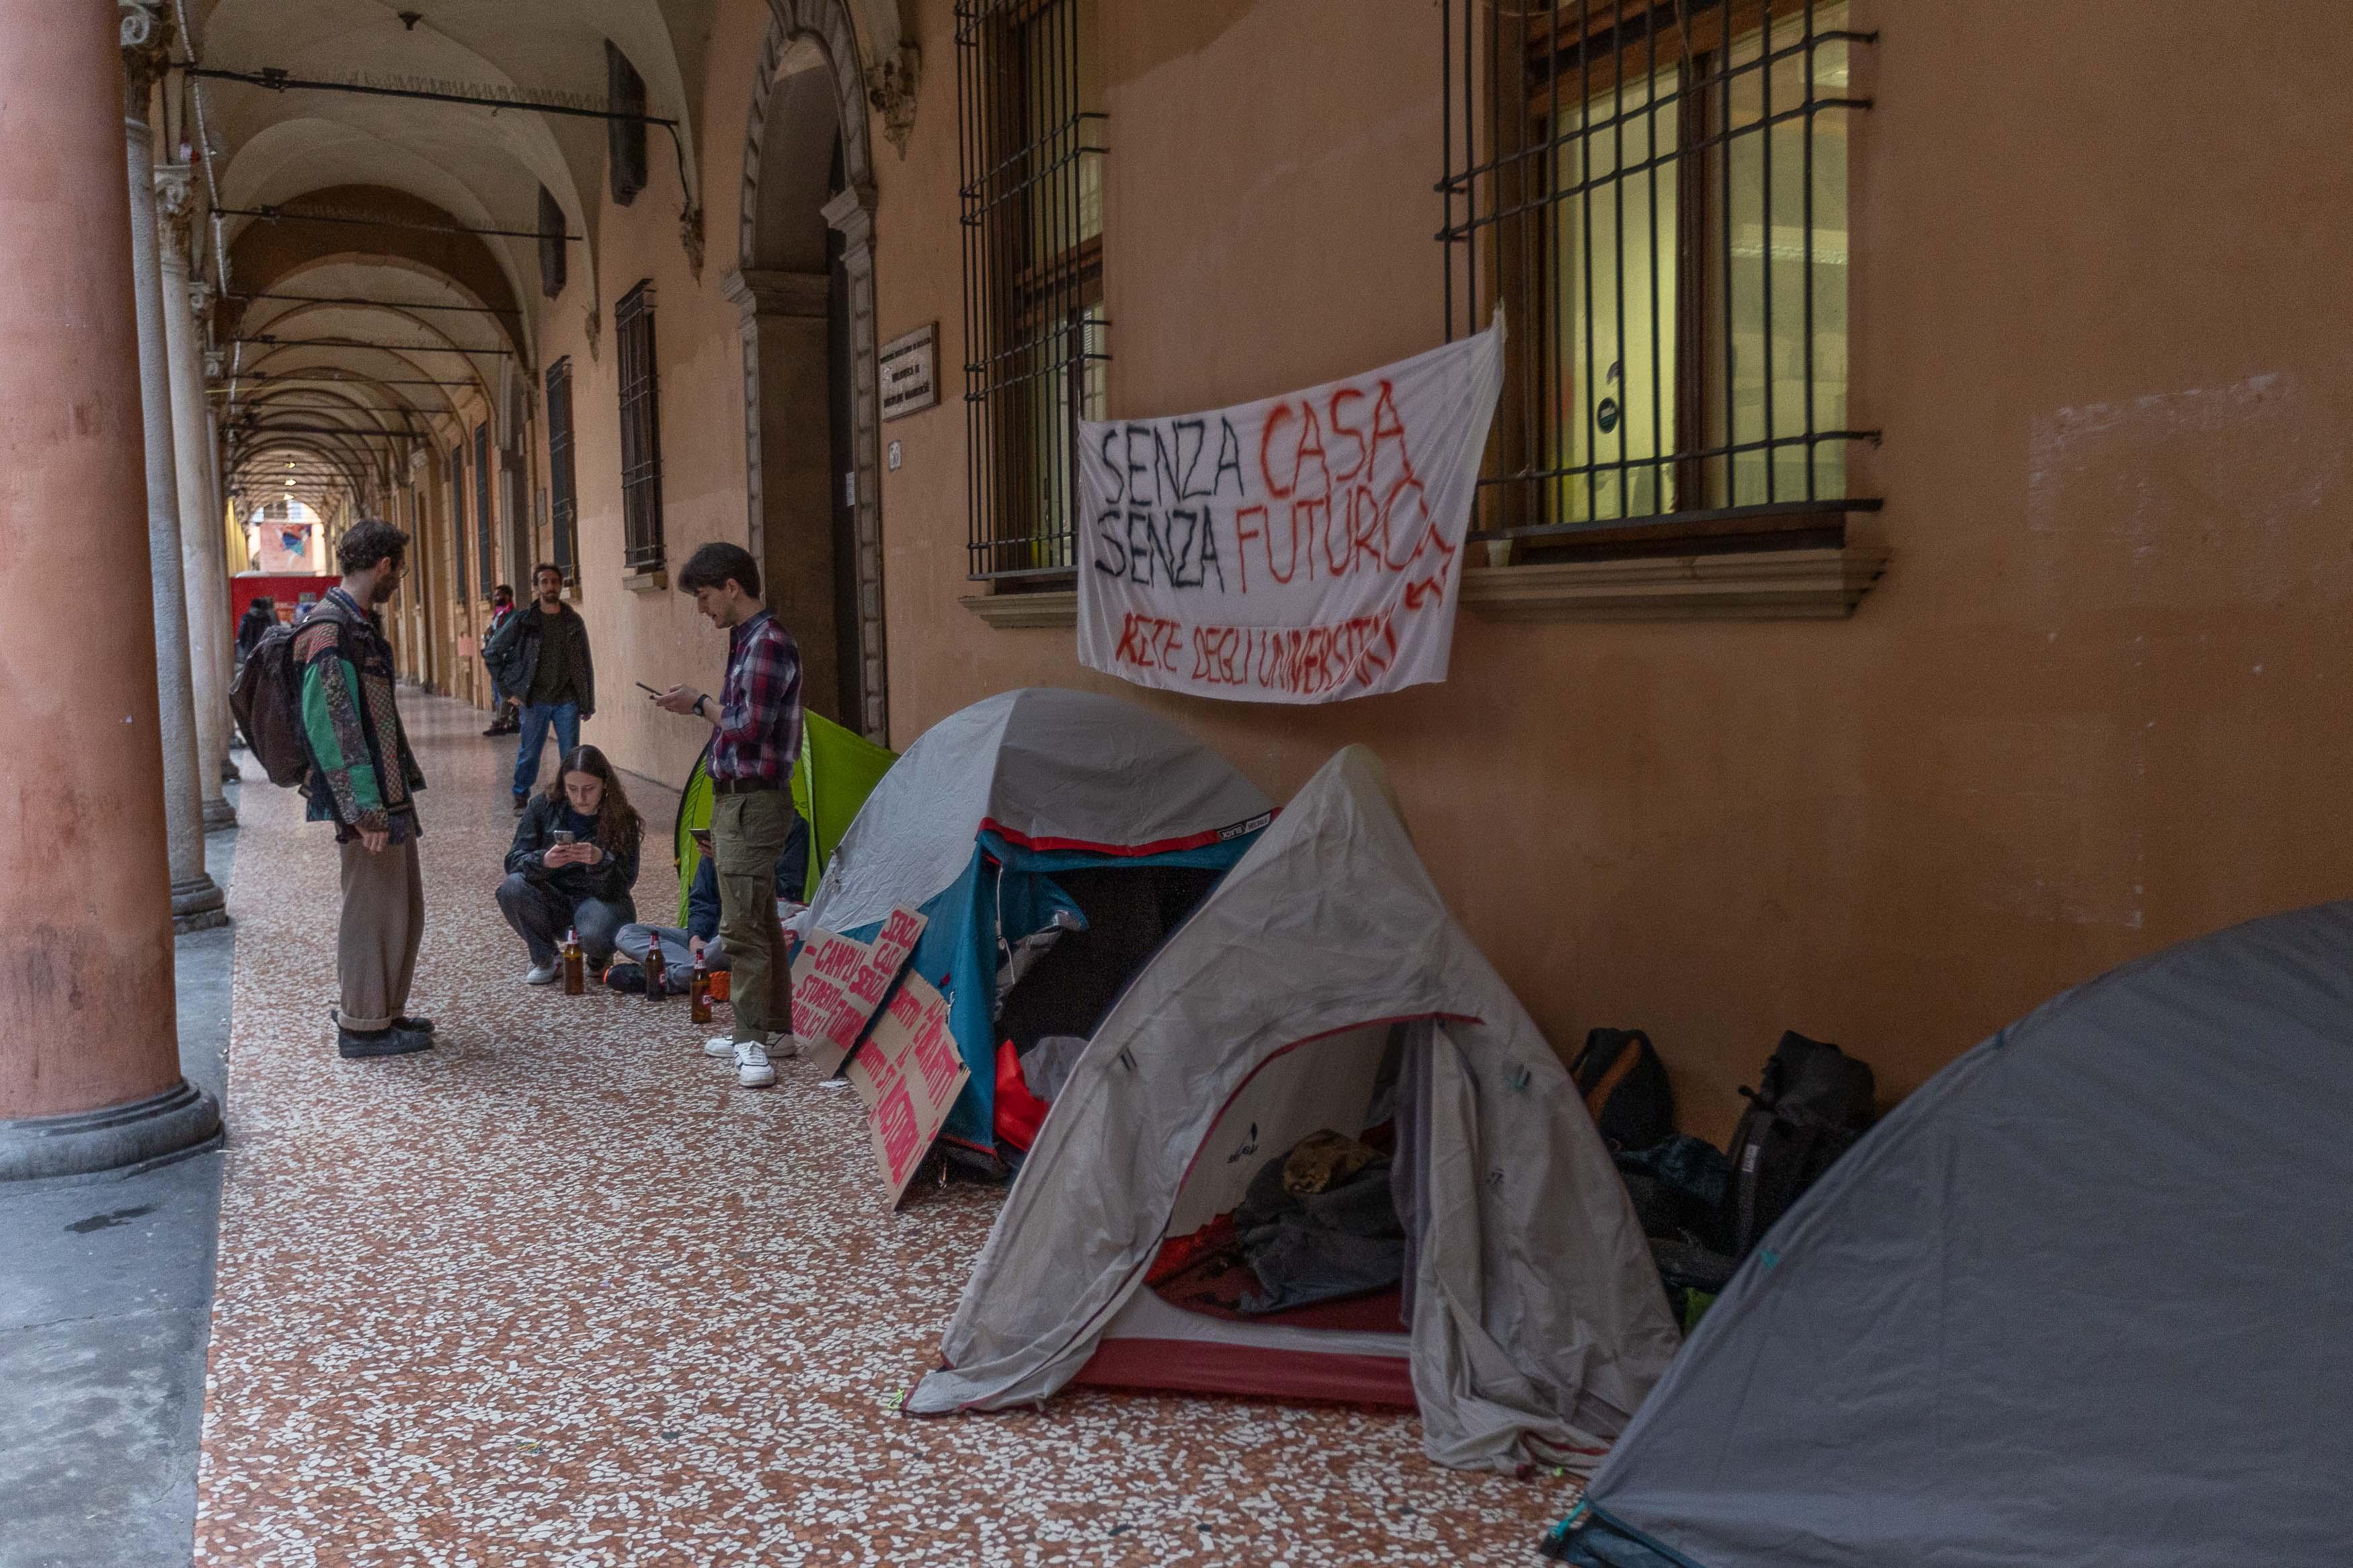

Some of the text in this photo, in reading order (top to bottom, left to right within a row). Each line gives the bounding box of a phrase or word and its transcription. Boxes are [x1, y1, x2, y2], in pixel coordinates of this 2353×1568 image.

[1101, 379, 1414, 507] SENZA CASA
[1094, 476, 1430, 593] SENZA FUTURO
[1115, 610, 1183, 672] RETE
[1192, 625, 1253, 685] DEGLI
[880, 908, 922, 951] SENZA
